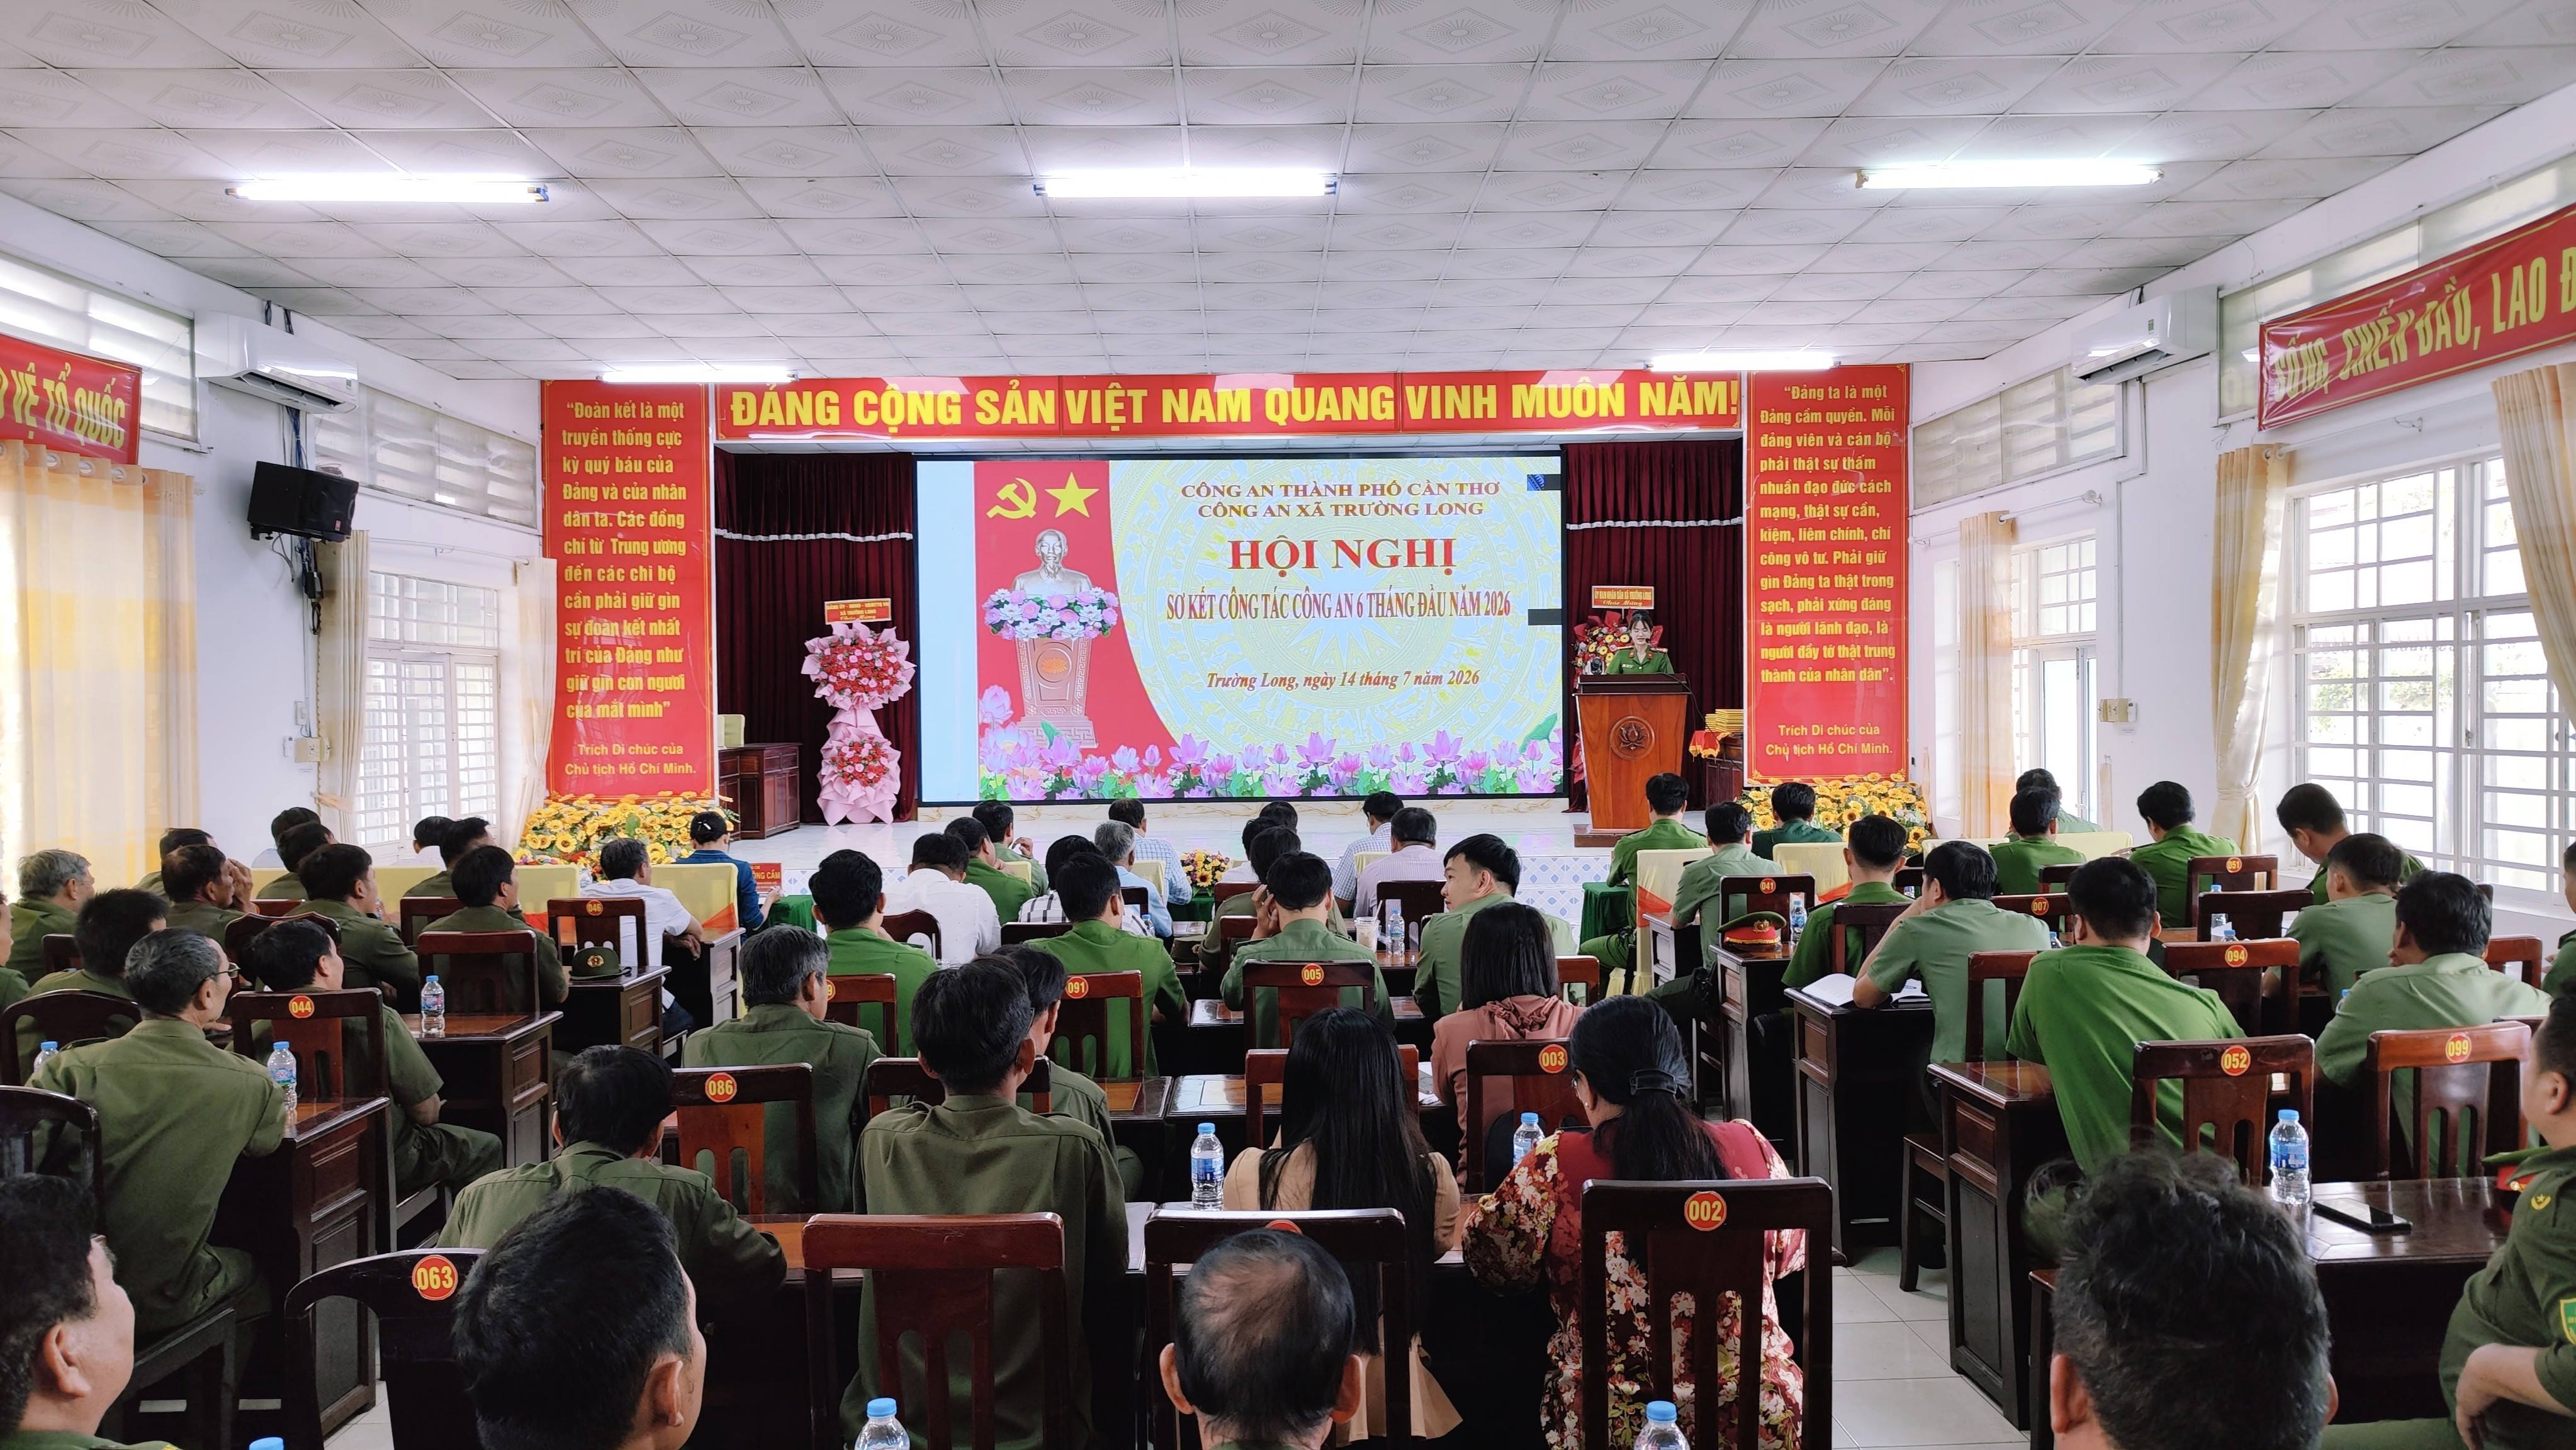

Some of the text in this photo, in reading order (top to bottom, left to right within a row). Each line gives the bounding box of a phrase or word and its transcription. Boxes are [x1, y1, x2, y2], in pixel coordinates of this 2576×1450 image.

[2491, 257, 2546, 334] LAO
[1828, 386, 1840, 399] ta
[1845, 385, 1857, 398] là
[1862, 385, 1887, 401] một
[11, 362, 40, 439] VỆ
[43, 362, 71, 435] TỔ
[74, 378, 125, 449] QUỐC
[614, 400, 636, 418] kết
[641, 402, 653, 418] là
[658, 402, 684, 422] một
[730, 374, 1738, 433] ĐẢNG CỘNG SẢN VIỆT NAM QUANG VINH MUÔN NĂM!
[1760, 406, 1894, 425] Đảng cầm quyền. Mỗi
[562, 427, 682, 449] truyền thống cực
[1760, 431, 1891, 448] đảng viên và cán bộ
[616, 456, 642, 473] báu
[647, 454, 673, 473] của
[563, 481, 686, 502] Đảng và của nhân
[1181, 481, 1242, 498] CÔNG
[1246, 485, 1274, 497] AN
[1280, 481, 1353, 497] THÀNH
[1358, 481, 1402, 497] PHỐ
[1455, 481, 1500, 495] THƠ
[1198, 501, 1484, 518] CÔNG AN XÃ TRƯỜNG LONG
[1760, 526, 1891, 544] kiệm, liêm chính, chí
[564, 537, 686, 556] chí từ Trung ương
[1227, 534, 1458, 577] HỘI NGHỊ
[1760, 551, 1791, 566] công
[1794, 551, 1809, 565] vô
[1833, 549, 1862, 564] Phải
[1865, 550, 1887, 565] giữ
[565, 563, 675, 585] đến các chi bộ
[1760, 573, 1894, 590] gìn Đảng ta thật trong
[565, 590, 680, 610] cần phải giữ gìn
[1167, 592, 1185, 620] SƠ
[1188, 587, 1216, 619] KẾT
[1218, 587, 1259, 619] CÔNG
[1261, 586, 1289, 619] TÁC
[1292, 585, 1332, 619] CÔNG
[1334, 593, 1353, 618] AN
[1356, 592, 1364, 618] 6
[1366, 585, 1414, 618] THÁNG
[1449, 584, 1480, 617] NĂM
[1484, 590, 1511, 616] 2026
[1760, 597, 1891, 615] sạch, phải xứng đáng
[1761, 620, 1888, 637] là người lãnh đạo, là
[1206, 670, 1480, 690] Trường Long, ngày 14 tháng 7 năm 2026
[1761, 669, 1796, 682] thành
[1799, 667, 1821, 682] của
[1825, 668, 1855, 682] nhân
[1778, 722, 1880, 736] Trích Di chúc của
[628, 743, 658, 755] chúc
[661, 742, 683, 755] của
[565, 761, 696, 777] Chủ tịch Hồ Chí Minh.
[2228, 861, 2240, 869] 051
[1762, 882, 1774, 891] 041
[588, 904, 601, 912] 046
[2033, 902, 2047, 911] 007
[2227, 950, 2245, 962] 094
[1305, 969, 1321, 980] 005
[1067, 982, 1085, 993] 091
[291, 1001, 312, 1013] 044
[2447, 1041, 2469, 1056] 099
[1542, 1052, 1565, 1067] 003
[2223, 1054, 2247, 1069] 052
[709, 1080, 734, 1095] 086
[1689, 1200, 1722, 1222] 002
[417, 1266, 454, 1290] 063
